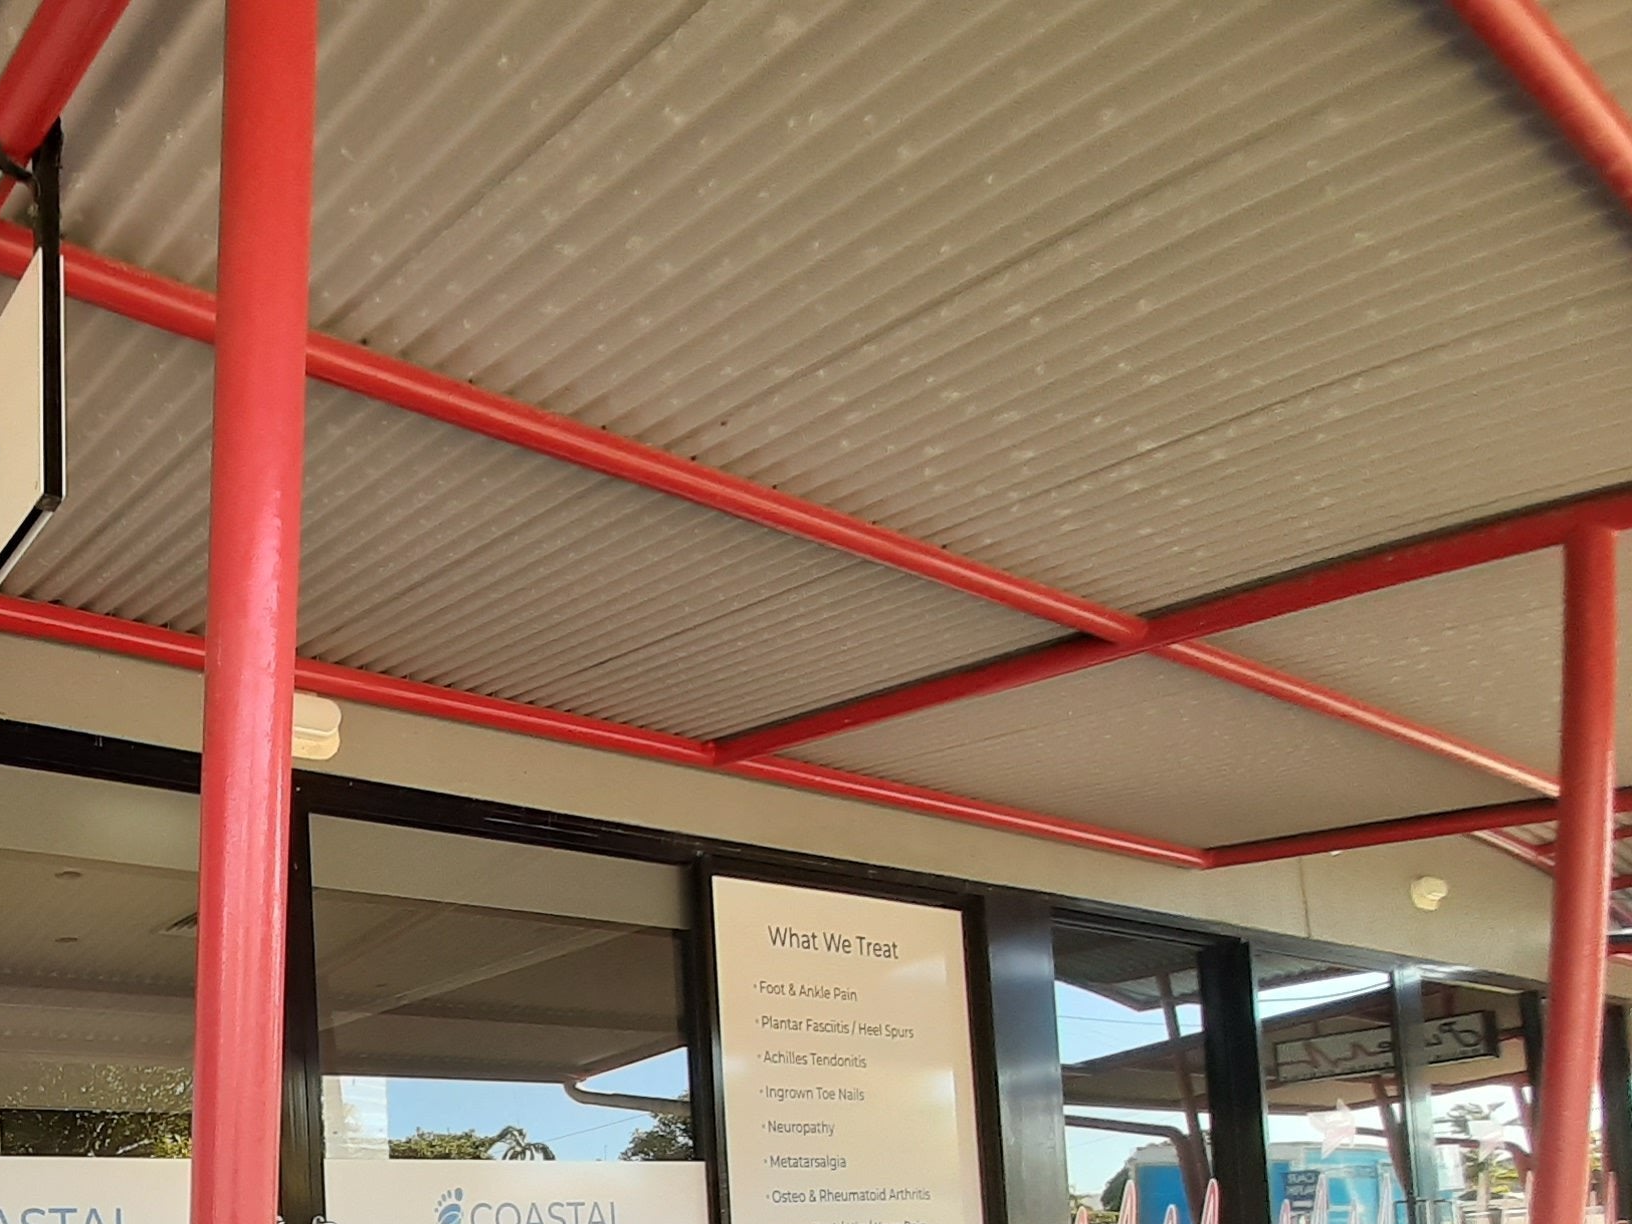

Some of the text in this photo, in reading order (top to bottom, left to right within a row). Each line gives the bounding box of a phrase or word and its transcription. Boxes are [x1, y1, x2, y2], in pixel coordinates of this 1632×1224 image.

[768, 926, 898, 959] What We Treat
[760, 981, 857, 1001] Foot & Ankle Pain
[762, 1016, 802, 1030] Plantar
[859, 1024, 882, 1036] Heel
[885, 1024, 914, 1039] Spurs
[764, 1051, 867, 1068] Achilles Tendonitis
[765, 1086, 864, 1102] Ingrown Toe Nails
[768, 1120, 833, 1136] Neuropathy
[770, 1156, 846, 1171] Metatarsalgia
[772, 1188, 930, 1203] Osteo & Rheumatoid Arthritis
